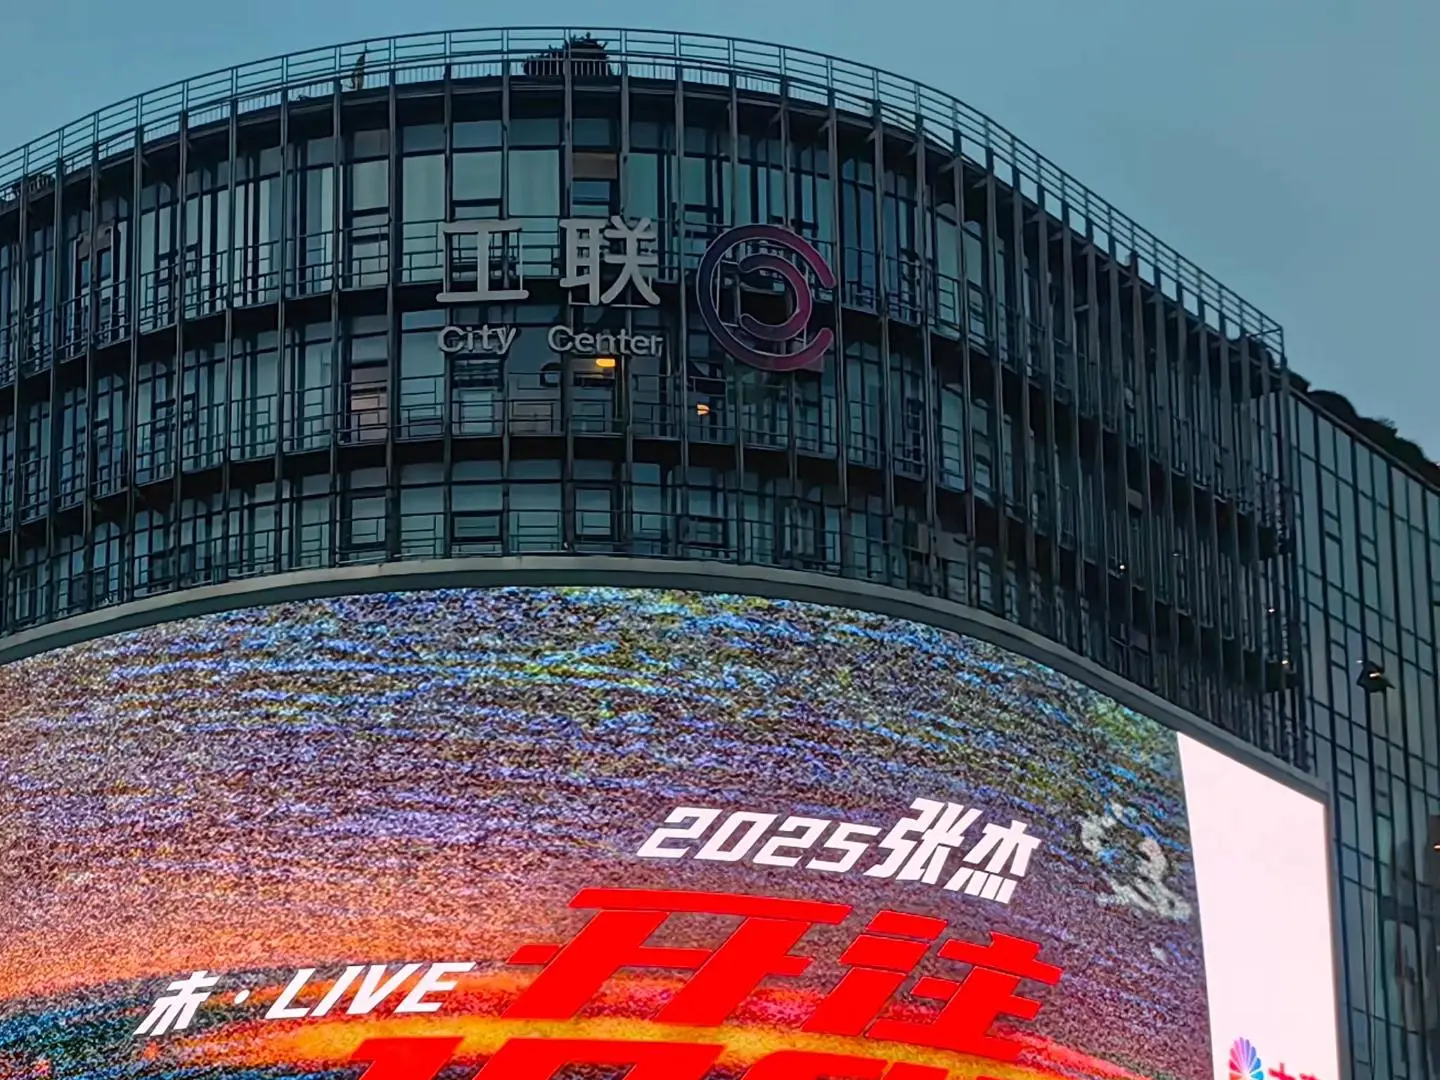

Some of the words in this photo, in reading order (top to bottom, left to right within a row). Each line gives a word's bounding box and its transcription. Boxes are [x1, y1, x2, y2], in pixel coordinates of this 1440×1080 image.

[436, 216, 660, 307] 工联
[438, 324, 517, 355] City
[547, 326, 663, 357] Center
[497, 886, 1065, 1060] 开往
